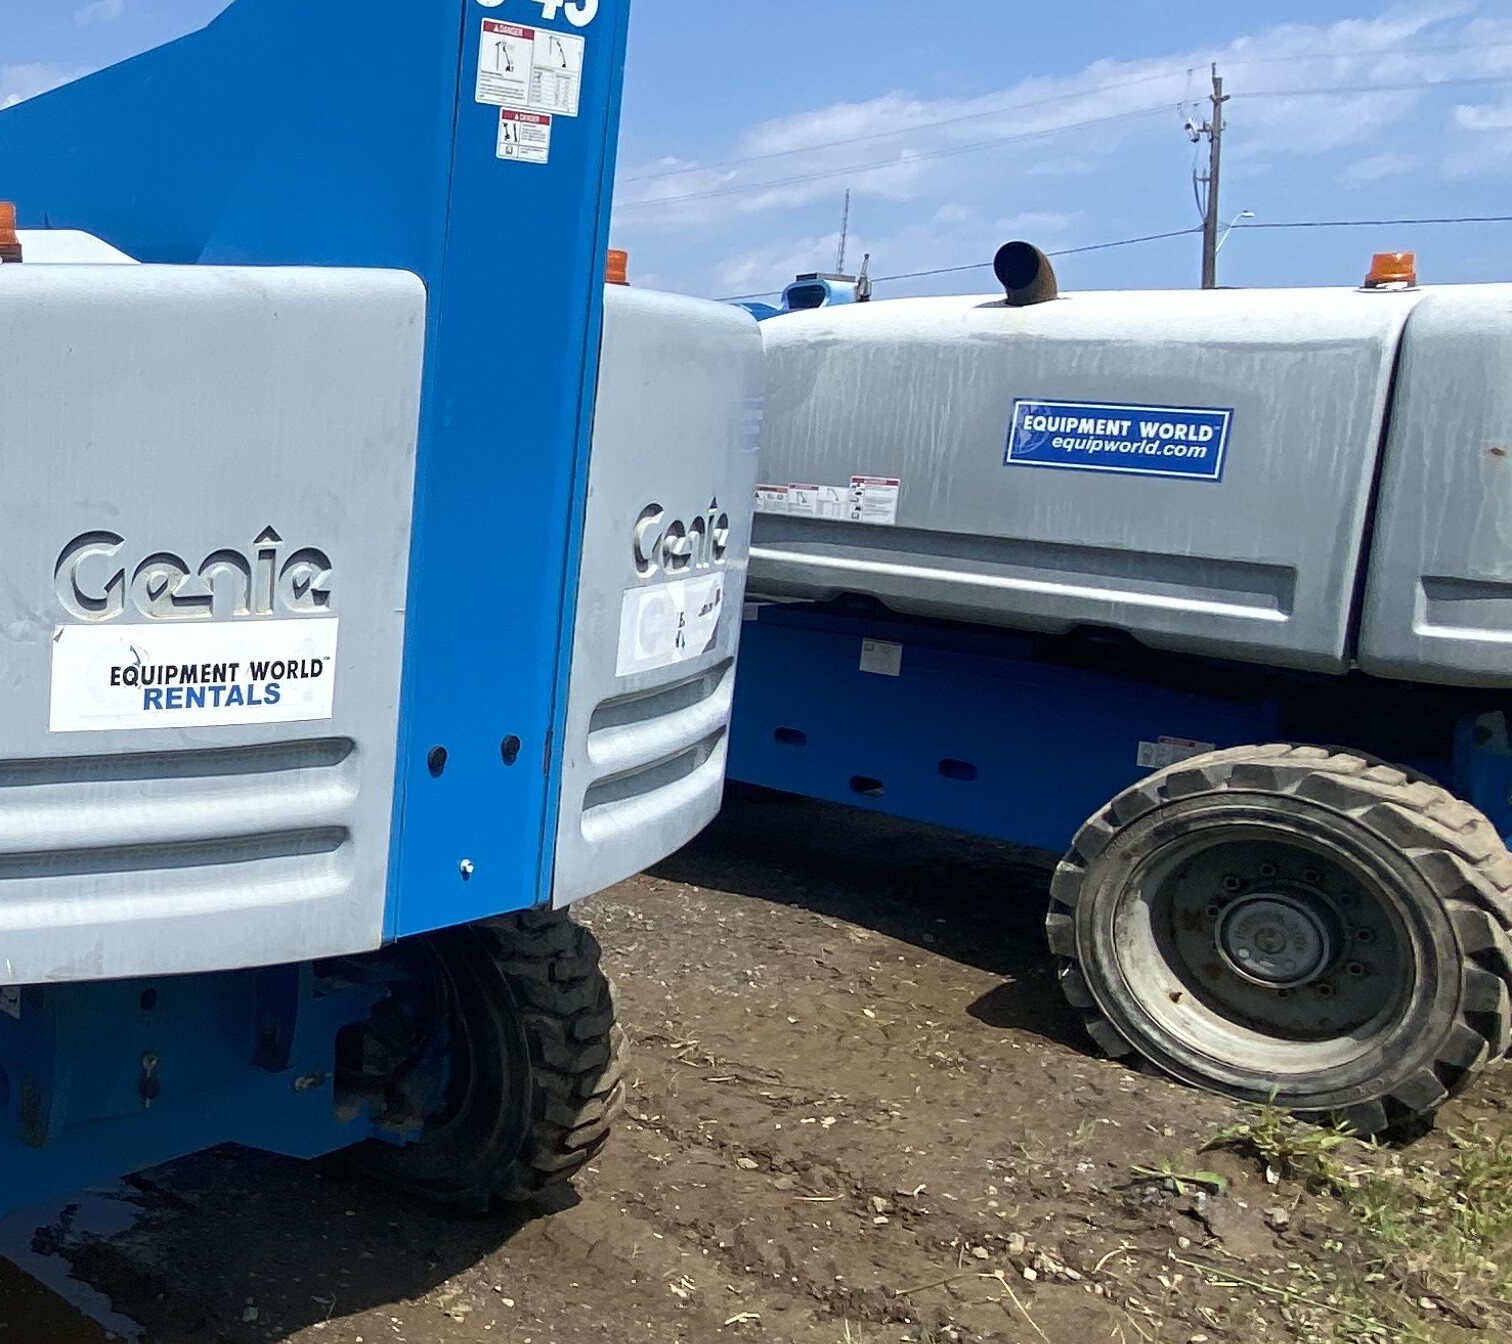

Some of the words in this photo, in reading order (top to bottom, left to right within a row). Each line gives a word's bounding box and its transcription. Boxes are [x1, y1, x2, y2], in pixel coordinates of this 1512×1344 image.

[1022, 414, 1132, 437] EQUIPMENT
[1051, 435, 1208, 459] equipworld.com
[633, 496, 729, 579] Genie
[53, 525, 333, 622] Genie
[110, 663, 239, 686] EQUIPMENT
[143, 682, 281, 711] RENTALS
